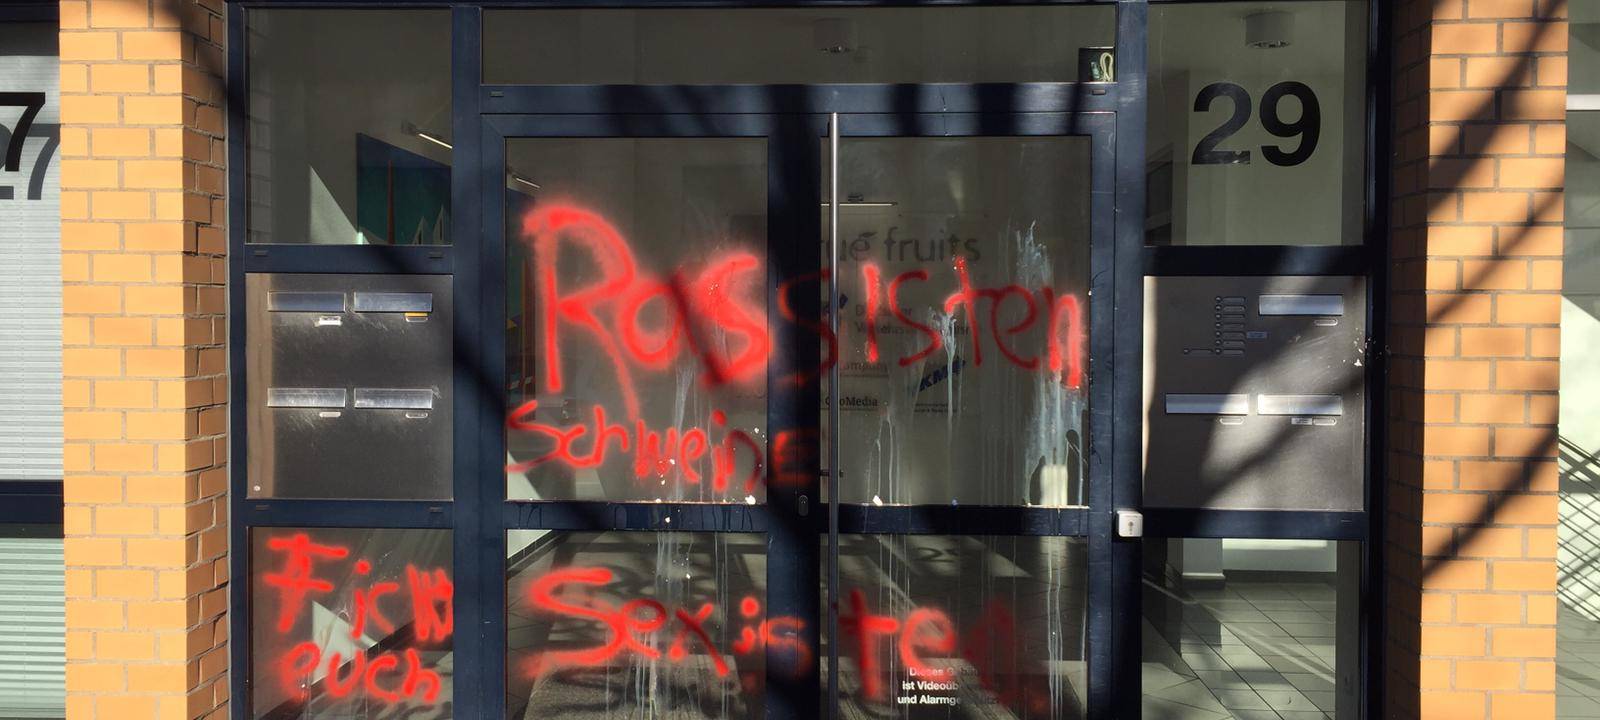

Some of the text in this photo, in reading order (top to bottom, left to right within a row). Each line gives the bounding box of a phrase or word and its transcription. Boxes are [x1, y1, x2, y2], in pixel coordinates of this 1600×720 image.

[1192, 81, 1321, 167] 29
[884, 227, 980, 262] fruits
[274, 641, 442, 703] euch
[902, 681, 915, 691] ist
[897, 695, 918, 705] und
